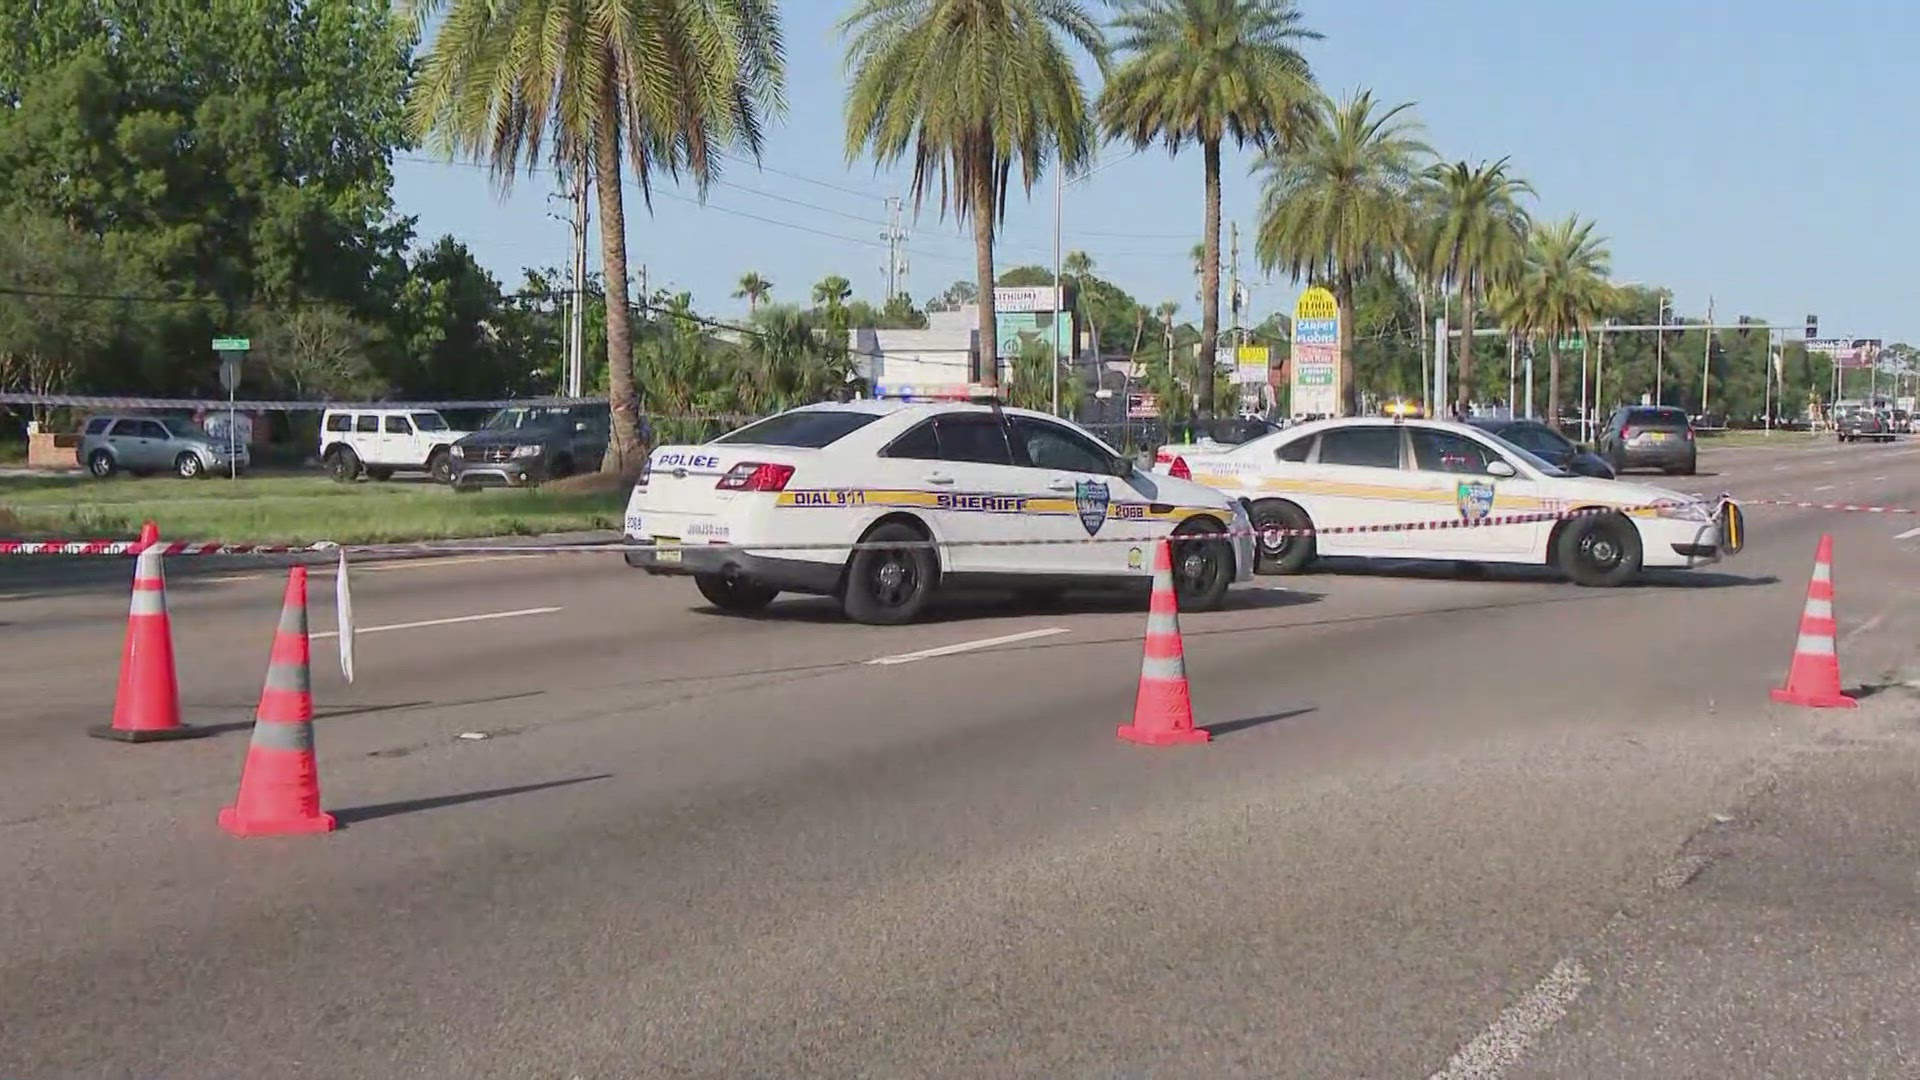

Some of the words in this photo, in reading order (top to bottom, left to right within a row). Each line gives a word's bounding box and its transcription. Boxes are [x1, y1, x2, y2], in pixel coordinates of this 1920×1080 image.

[1297, 321, 1334, 331] CARPET
[1297, 334, 1335, 343] FLOORS
[659, 454, 720, 468] POLICE
[794, 492, 832, 505] DIAL
[837, 491, 866, 505] 911
[936, 495, 1028, 511] SHERIFF
